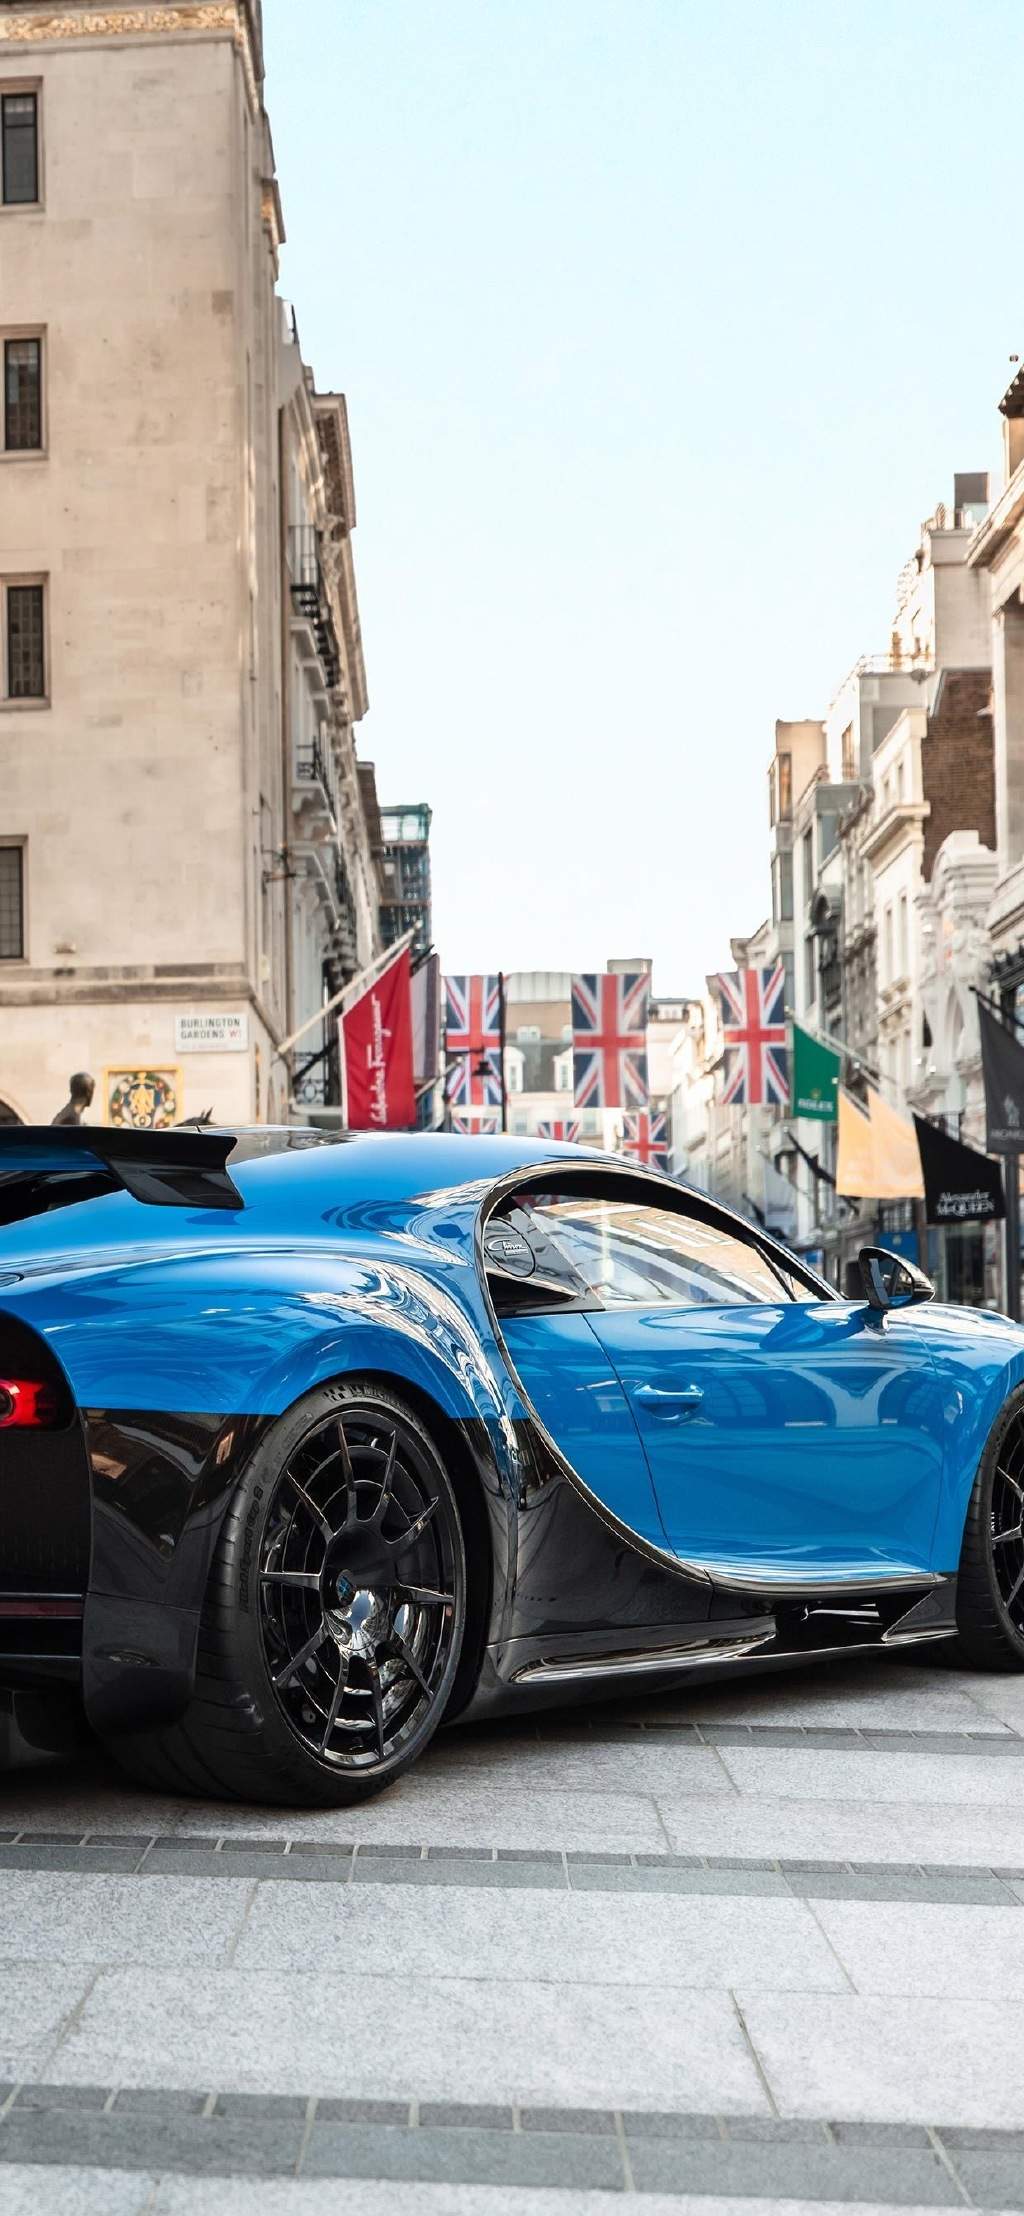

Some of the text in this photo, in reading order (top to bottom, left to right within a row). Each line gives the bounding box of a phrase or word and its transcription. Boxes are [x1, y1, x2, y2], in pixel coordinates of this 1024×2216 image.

[180, 1018, 240, 1028] BURLINGTON
[180, 1029, 225, 1039] GARDENS
[798, 1098, 833, 1112] ROLEX
[940, 1189, 991, 1201] Alexander
